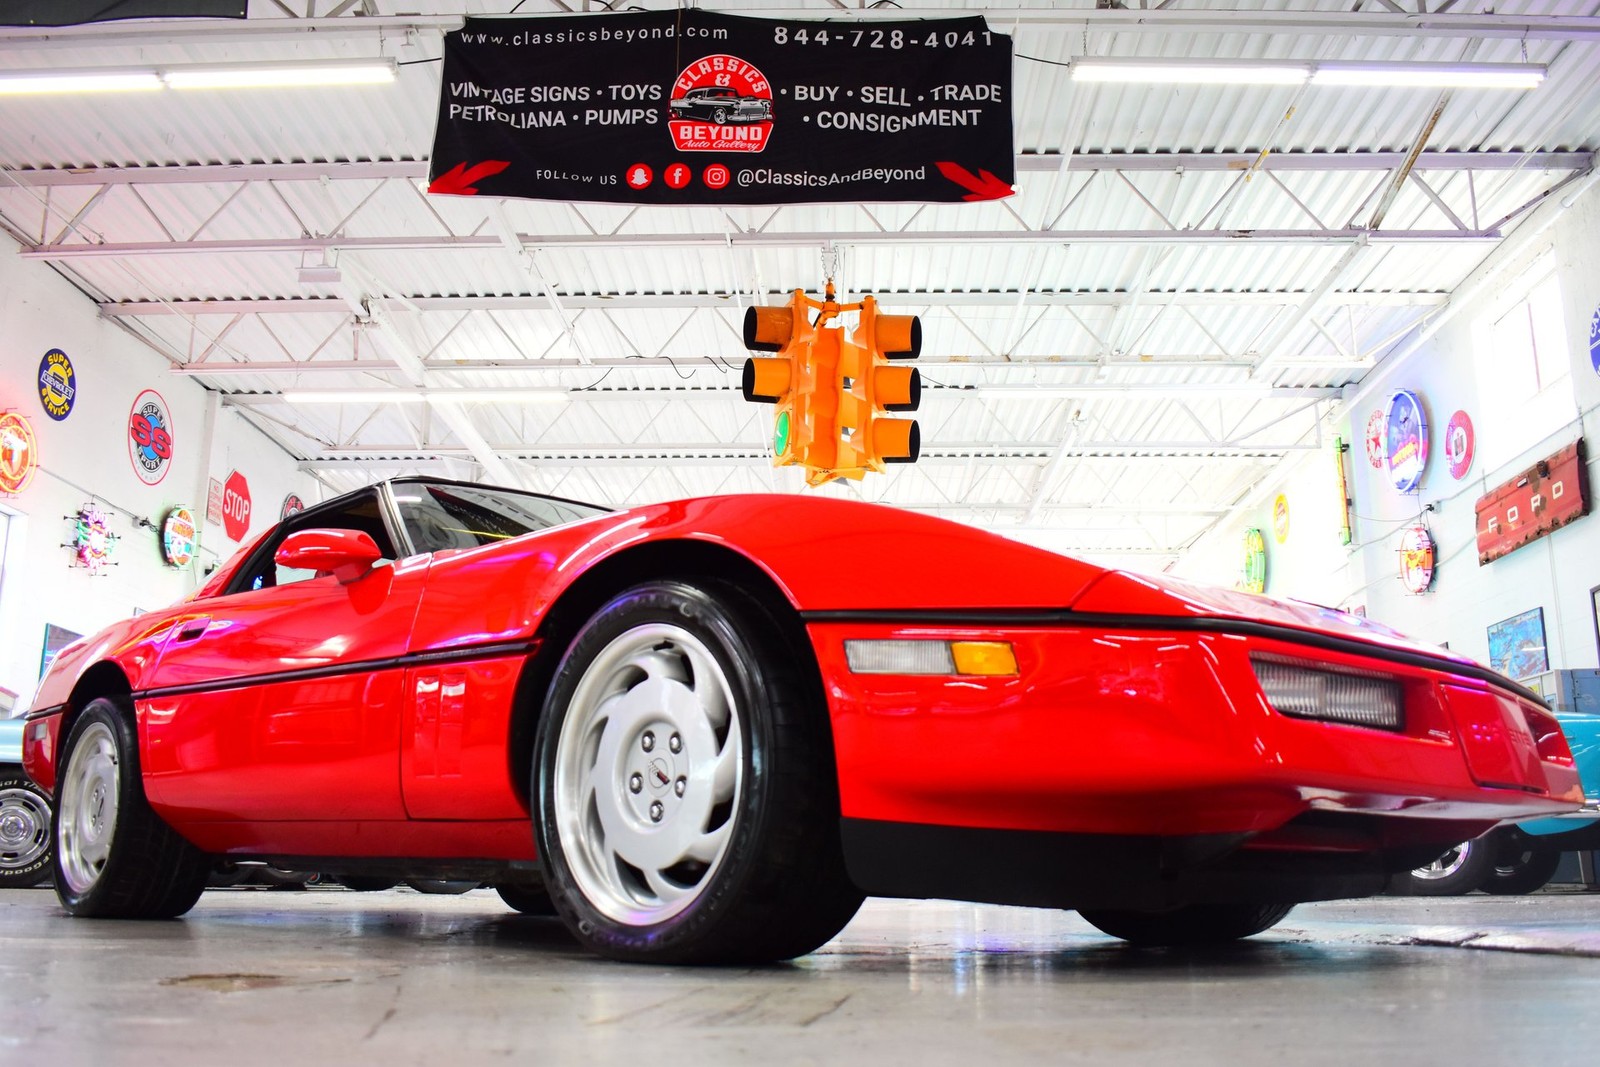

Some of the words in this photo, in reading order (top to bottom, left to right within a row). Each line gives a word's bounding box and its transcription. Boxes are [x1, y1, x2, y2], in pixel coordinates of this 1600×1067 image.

[461, 25, 728, 46] www.classicsbeyond.com
[774, 26, 992, 49] 844-728-4041
[677, 57, 767, 93] CLASSICS
[715, 73, 731, 87] &
[450, 82, 525, 104] VINTAGE
[530, 86, 590, 102] SIGNS
[608, 84, 662, 101] TOYS
[794, 85, 839, 102] BUY
[861, 86, 911, 106] SELL
[930, 84, 1002, 103] TRADE
[450, 104, 566, 129] PETROLIANA
[585, 109, 658, 125] PUMPS
[817, 109, 982, 133] CONSIGNMENT
[680, 126, 763, 140] BEYOND
[681, 140, 710, 148] Auto
[713, 140, 760, 151] Gallery
[536, 169, 593, 182] FOLLOW
[600, 174, 617, 185] US
[737, 166, 925, 187] @ClassicsAndBeyond
[47, 353, 73, 378] SUPER
[41, 388, 70, 416] SERVICE
[131, 413, 171, 459] SS
[224, 488, 249, 523] STOP
[1488, 481, 1563, 533] FORD
